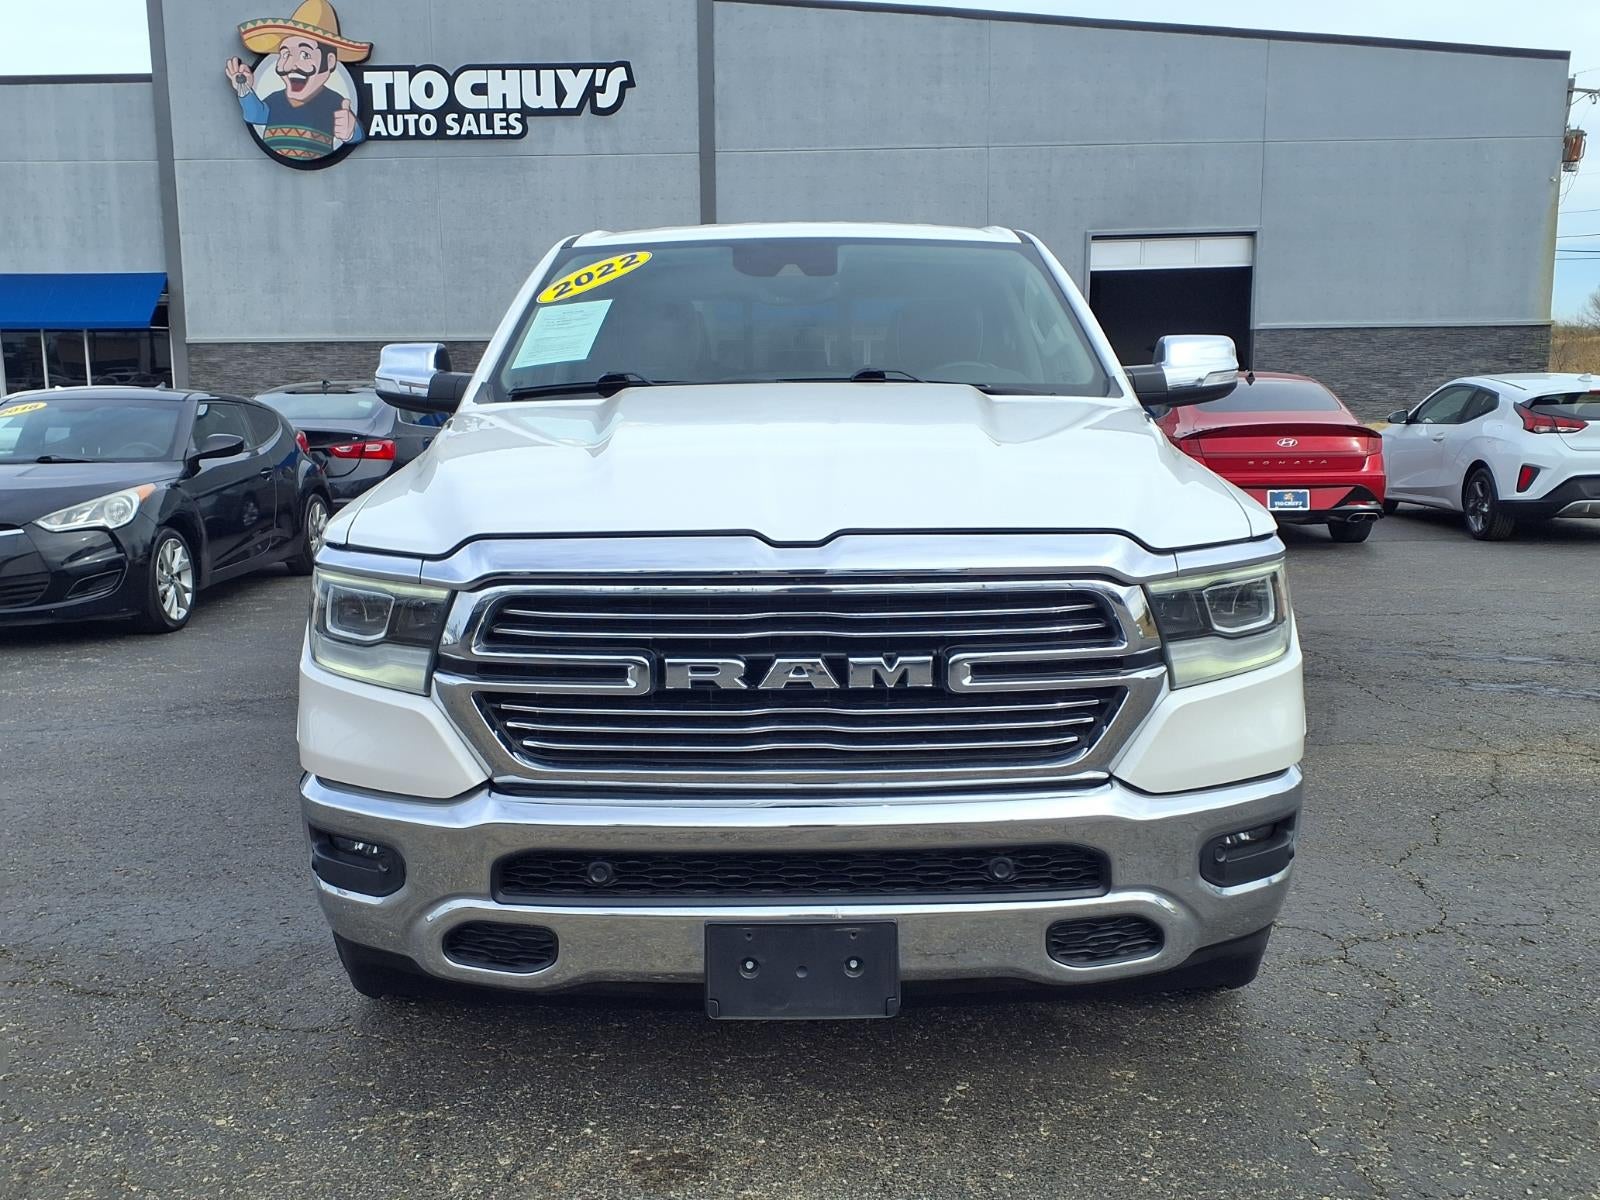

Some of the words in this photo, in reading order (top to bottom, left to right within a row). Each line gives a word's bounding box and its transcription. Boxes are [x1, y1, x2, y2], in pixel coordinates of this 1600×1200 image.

[363, 70, 449, 111] TIO
[453, 66, 628, 110] CHUY'S
[369, 113, 438, 137] AUTO
[446, 112, 523, 136] SALES
[552, 253, 641, 299] 2022
[664, 656, 933, 689] RAM
